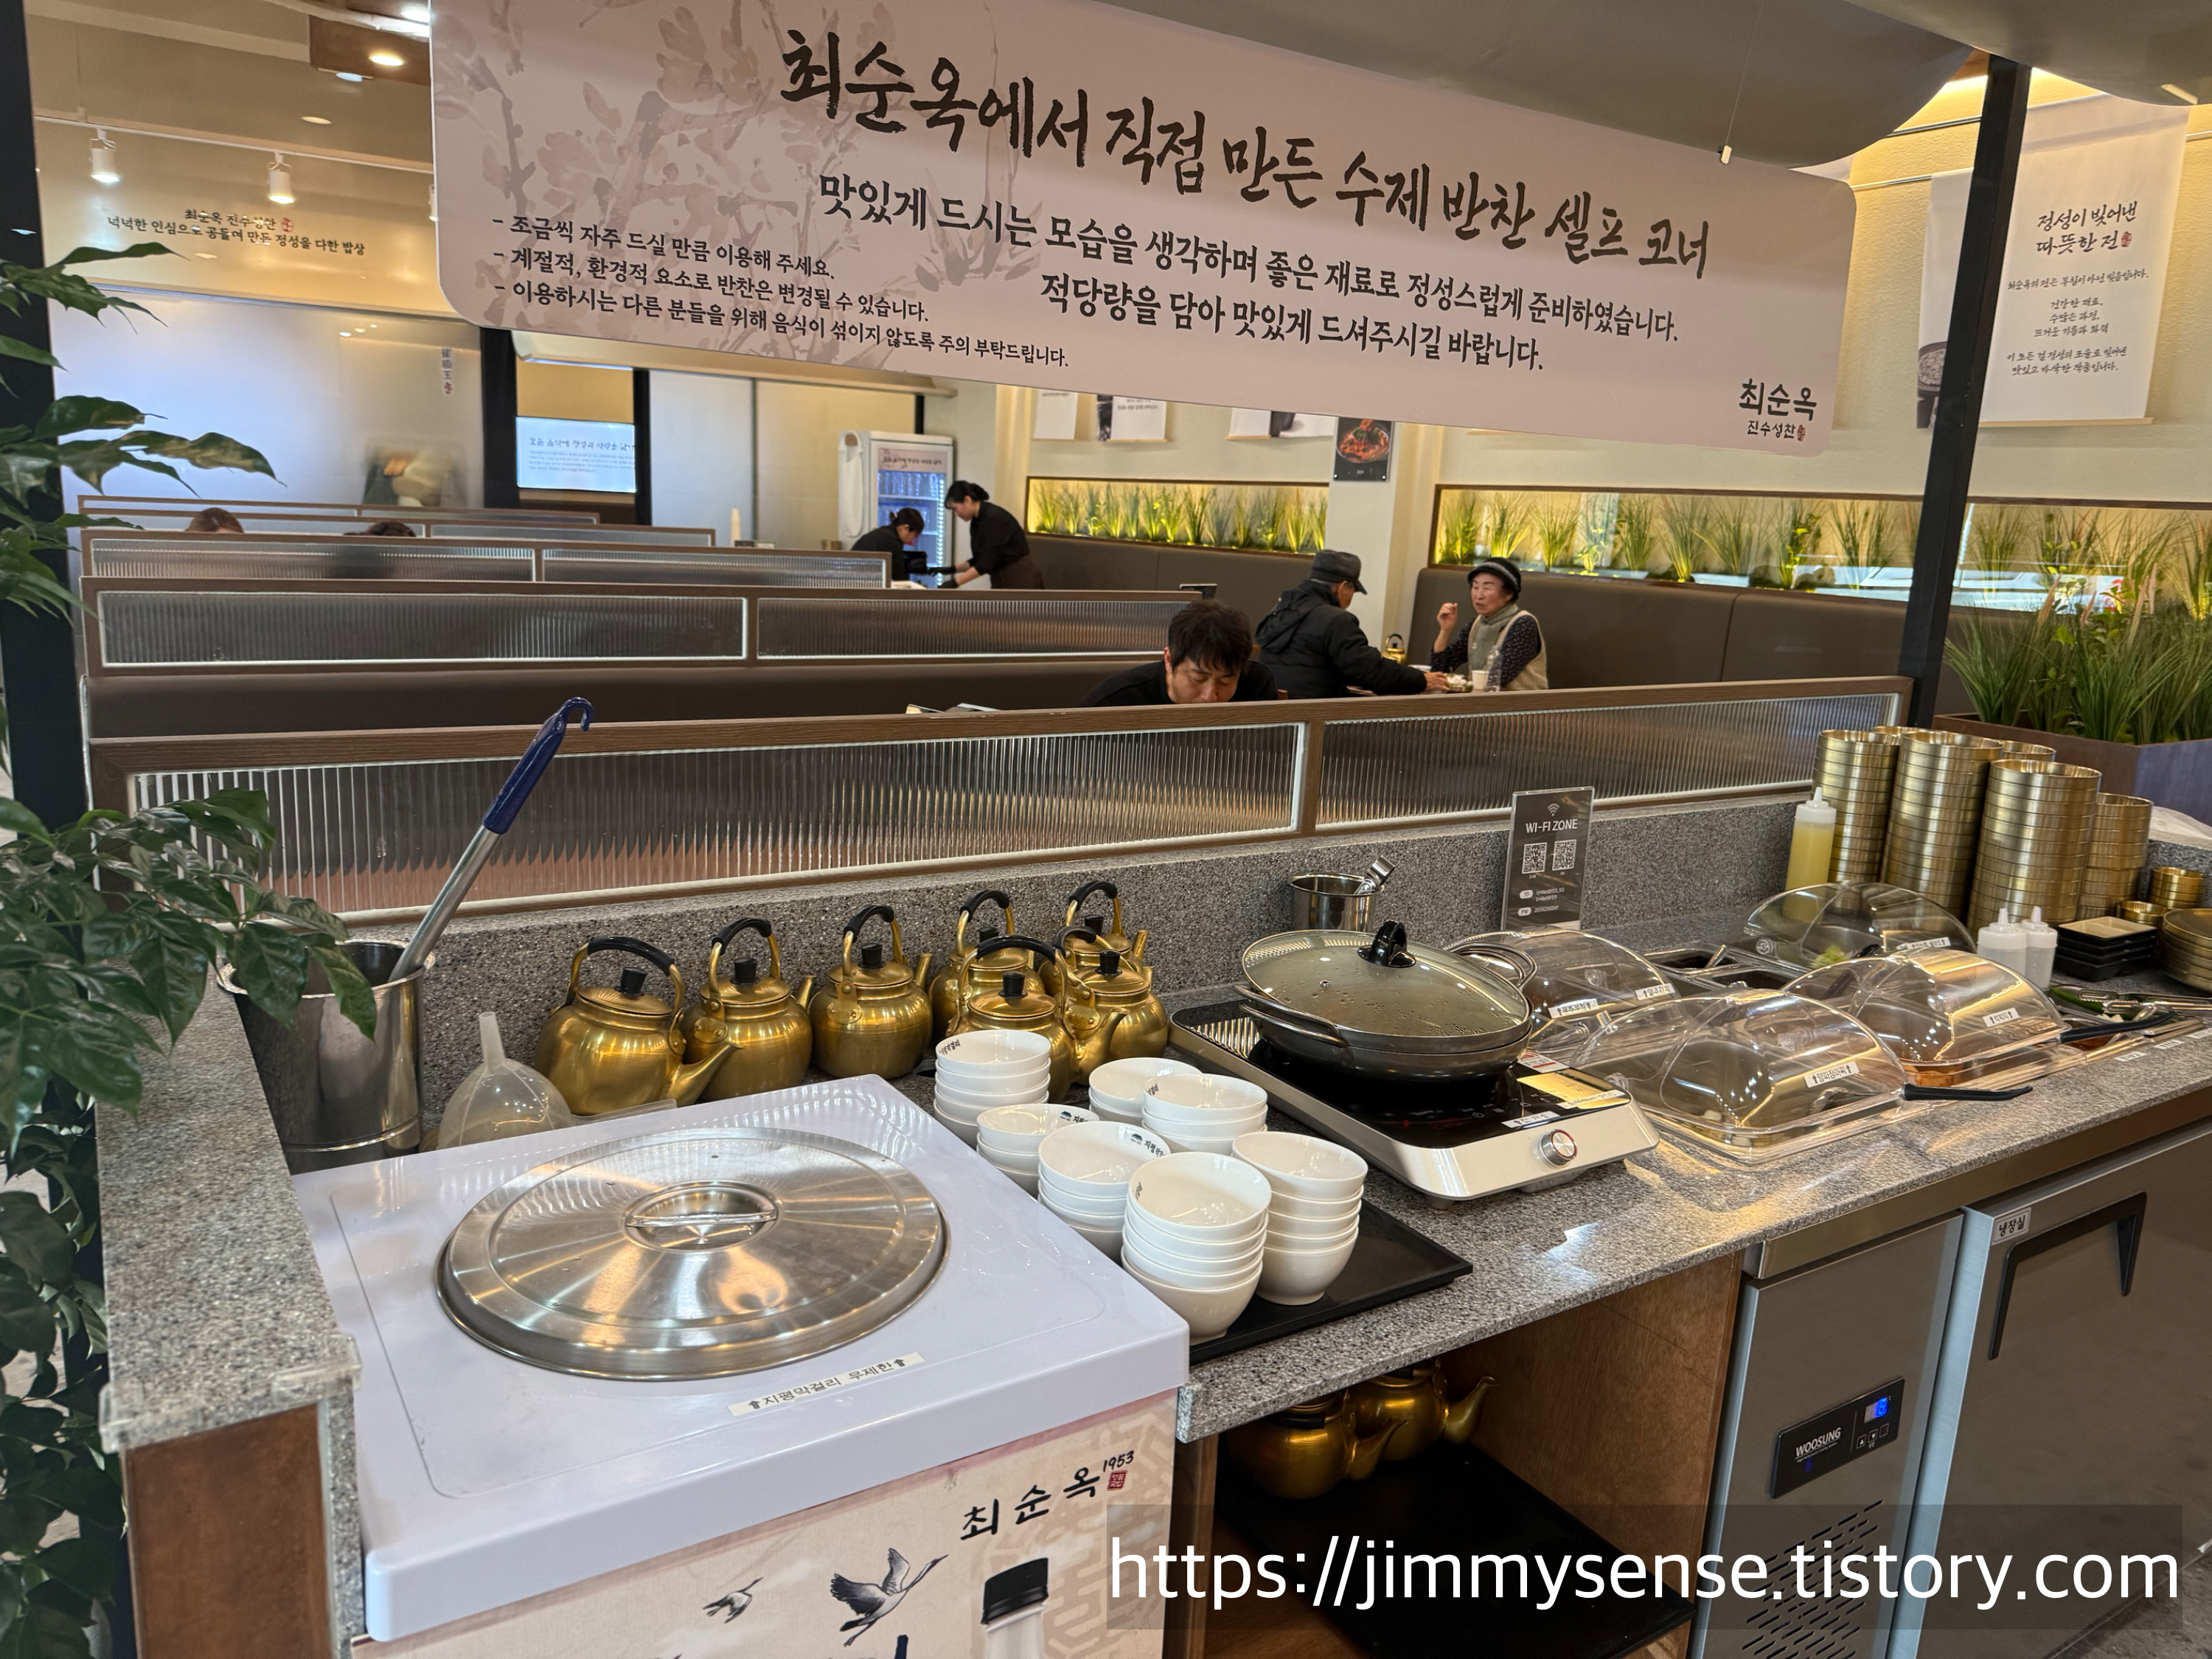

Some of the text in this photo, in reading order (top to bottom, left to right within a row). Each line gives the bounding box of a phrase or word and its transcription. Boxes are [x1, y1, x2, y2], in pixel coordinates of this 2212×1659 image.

[780, 29, 1709, 279] 최순옥에서 직접 만든 수제 반찬 셀프 코너
[107, 216, 366, 256] 넉넉한 인심으로 공들여 만든 정성을 다한 밥상
[2037, 201, 2138, 232] 정성이 빚어낸
[510, 216, 573, 243] 조금씩
[580, 223, 622, 249] 자주
[626, 232, 666, 257] 드실
[672, 237, 711, 262] 만큼
[716, 244, 771, 271] 이용해
[776, 254, 835, 279] 주세요.
[820, 173, 1679, 343] 맛있게 드시는 모습을 생각하며 좋은 재료로 정성스럽게 준비하였습니다.
[2036, 232, 2097, 255] 따뜻한
[2101, 230, 2118, 250] 전
[511, 247, 581, 278] 계절적,
[587, 256, 647, 285] 환경적
[653, 267, 712, 291] 요소로
[717, 275, 773, 302] 반찬은
[778, 283, 831, 310] 변경될
[835, 292, 853, 311] 수
[858, 294, 929, 321] 있습니다.
[512, 280, 617, 313] 이용하시는
[622, 293, 662, 318] 다른
[667, 299, 725, 326] 분들을
[731, 307, 767, 331] 위해
[772, 312, 824, 338] 음식이
[830, 320, 880, 345] 섞이지
[886, 327, 935, 352] 않도록
[938, 335, 970, 356] 주의
[974, 339, 1068, 367] 부탁드립니다.
[1041, 272, 1544, 370] 적당량을 담아 맛있게 드셔주시길 바랍니다.
[1739, 378, 1817, 421] 최순옥
[1747, 420, 1795, 439] 진수성찬
[1526, 818, 1578, 833] WI-FI ZONE
[1999, 1214, 2026, 1237] 냉장실
[764, 1362, 894, 1406] 지평막걸리 무제한
[1102, 1450, 1134, 1472] 1953
[1796, 1427, 1842, 1456] WOOSUNG
